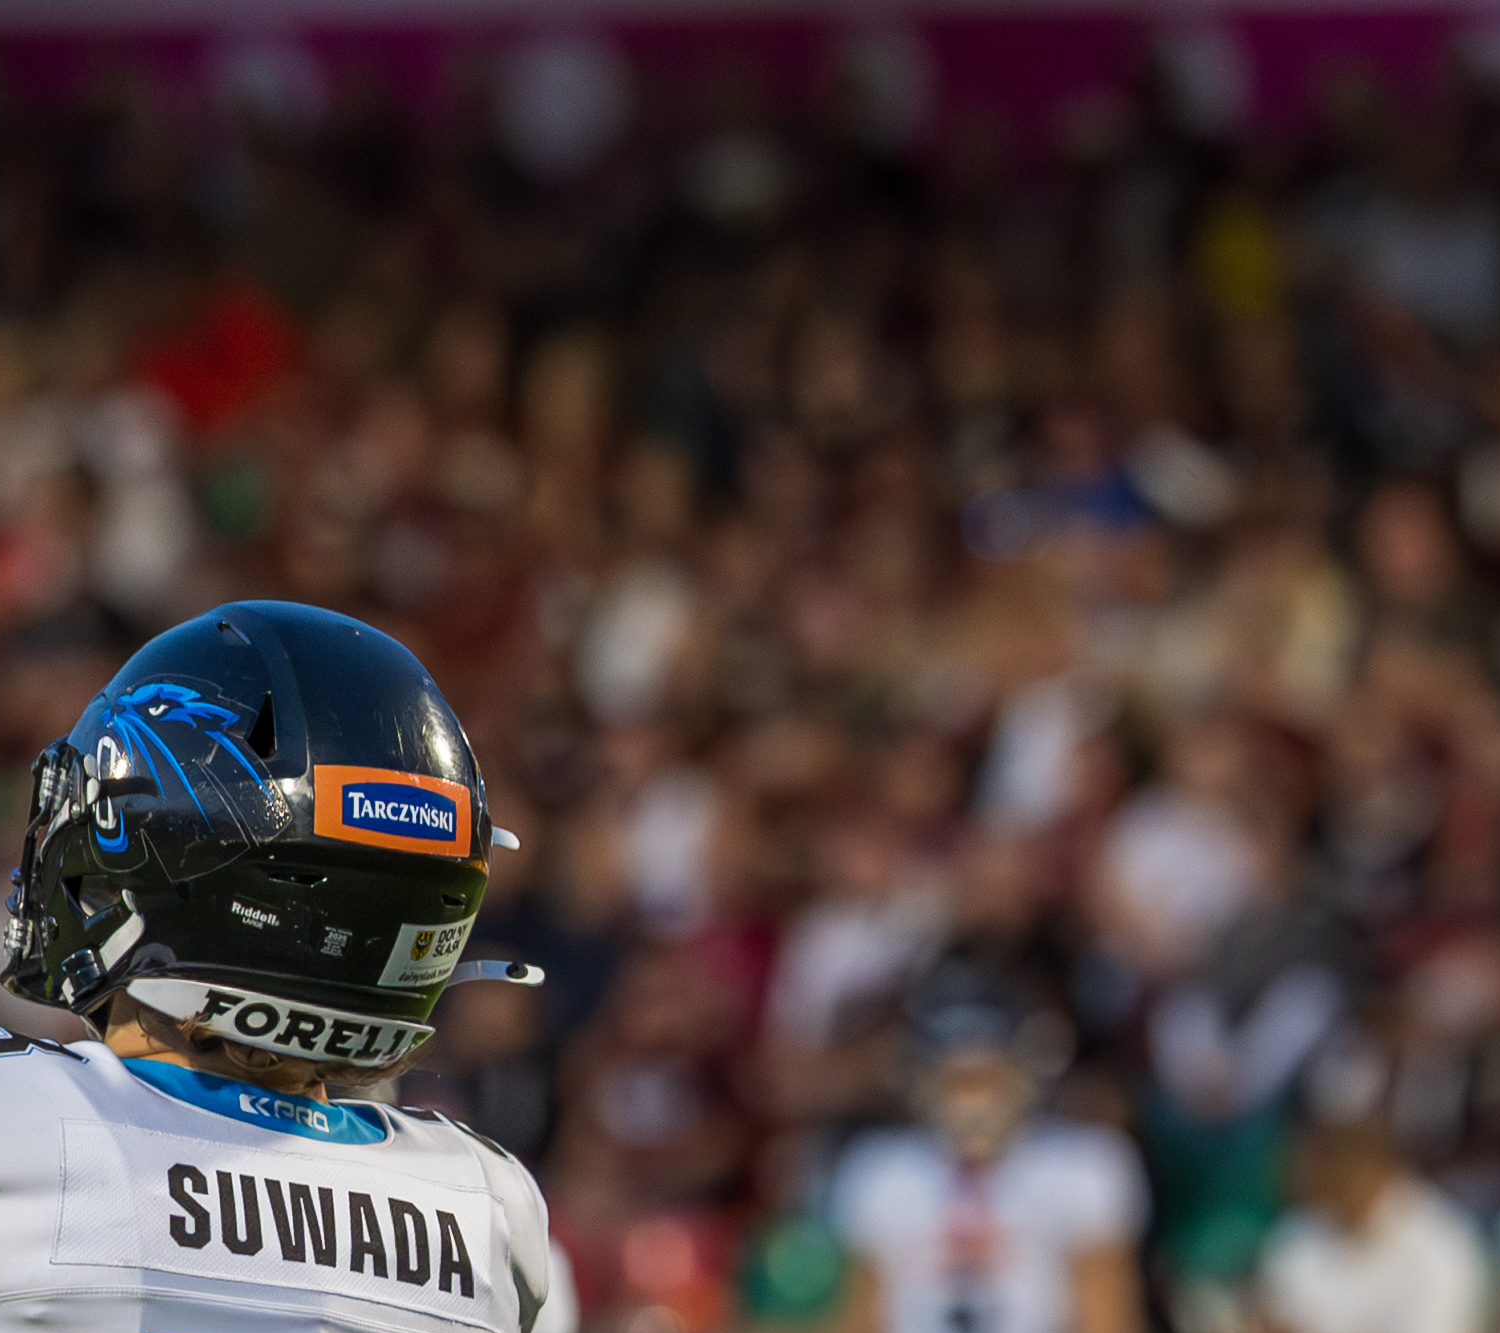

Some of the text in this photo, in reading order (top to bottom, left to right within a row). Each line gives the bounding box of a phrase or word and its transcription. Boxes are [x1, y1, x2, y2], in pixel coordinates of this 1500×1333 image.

[347, 791, 453, 833] TARCZYŃSKI
[231, 901, 277, 926] Riddell
[167, 1163, 475, 1299] SUWADA
